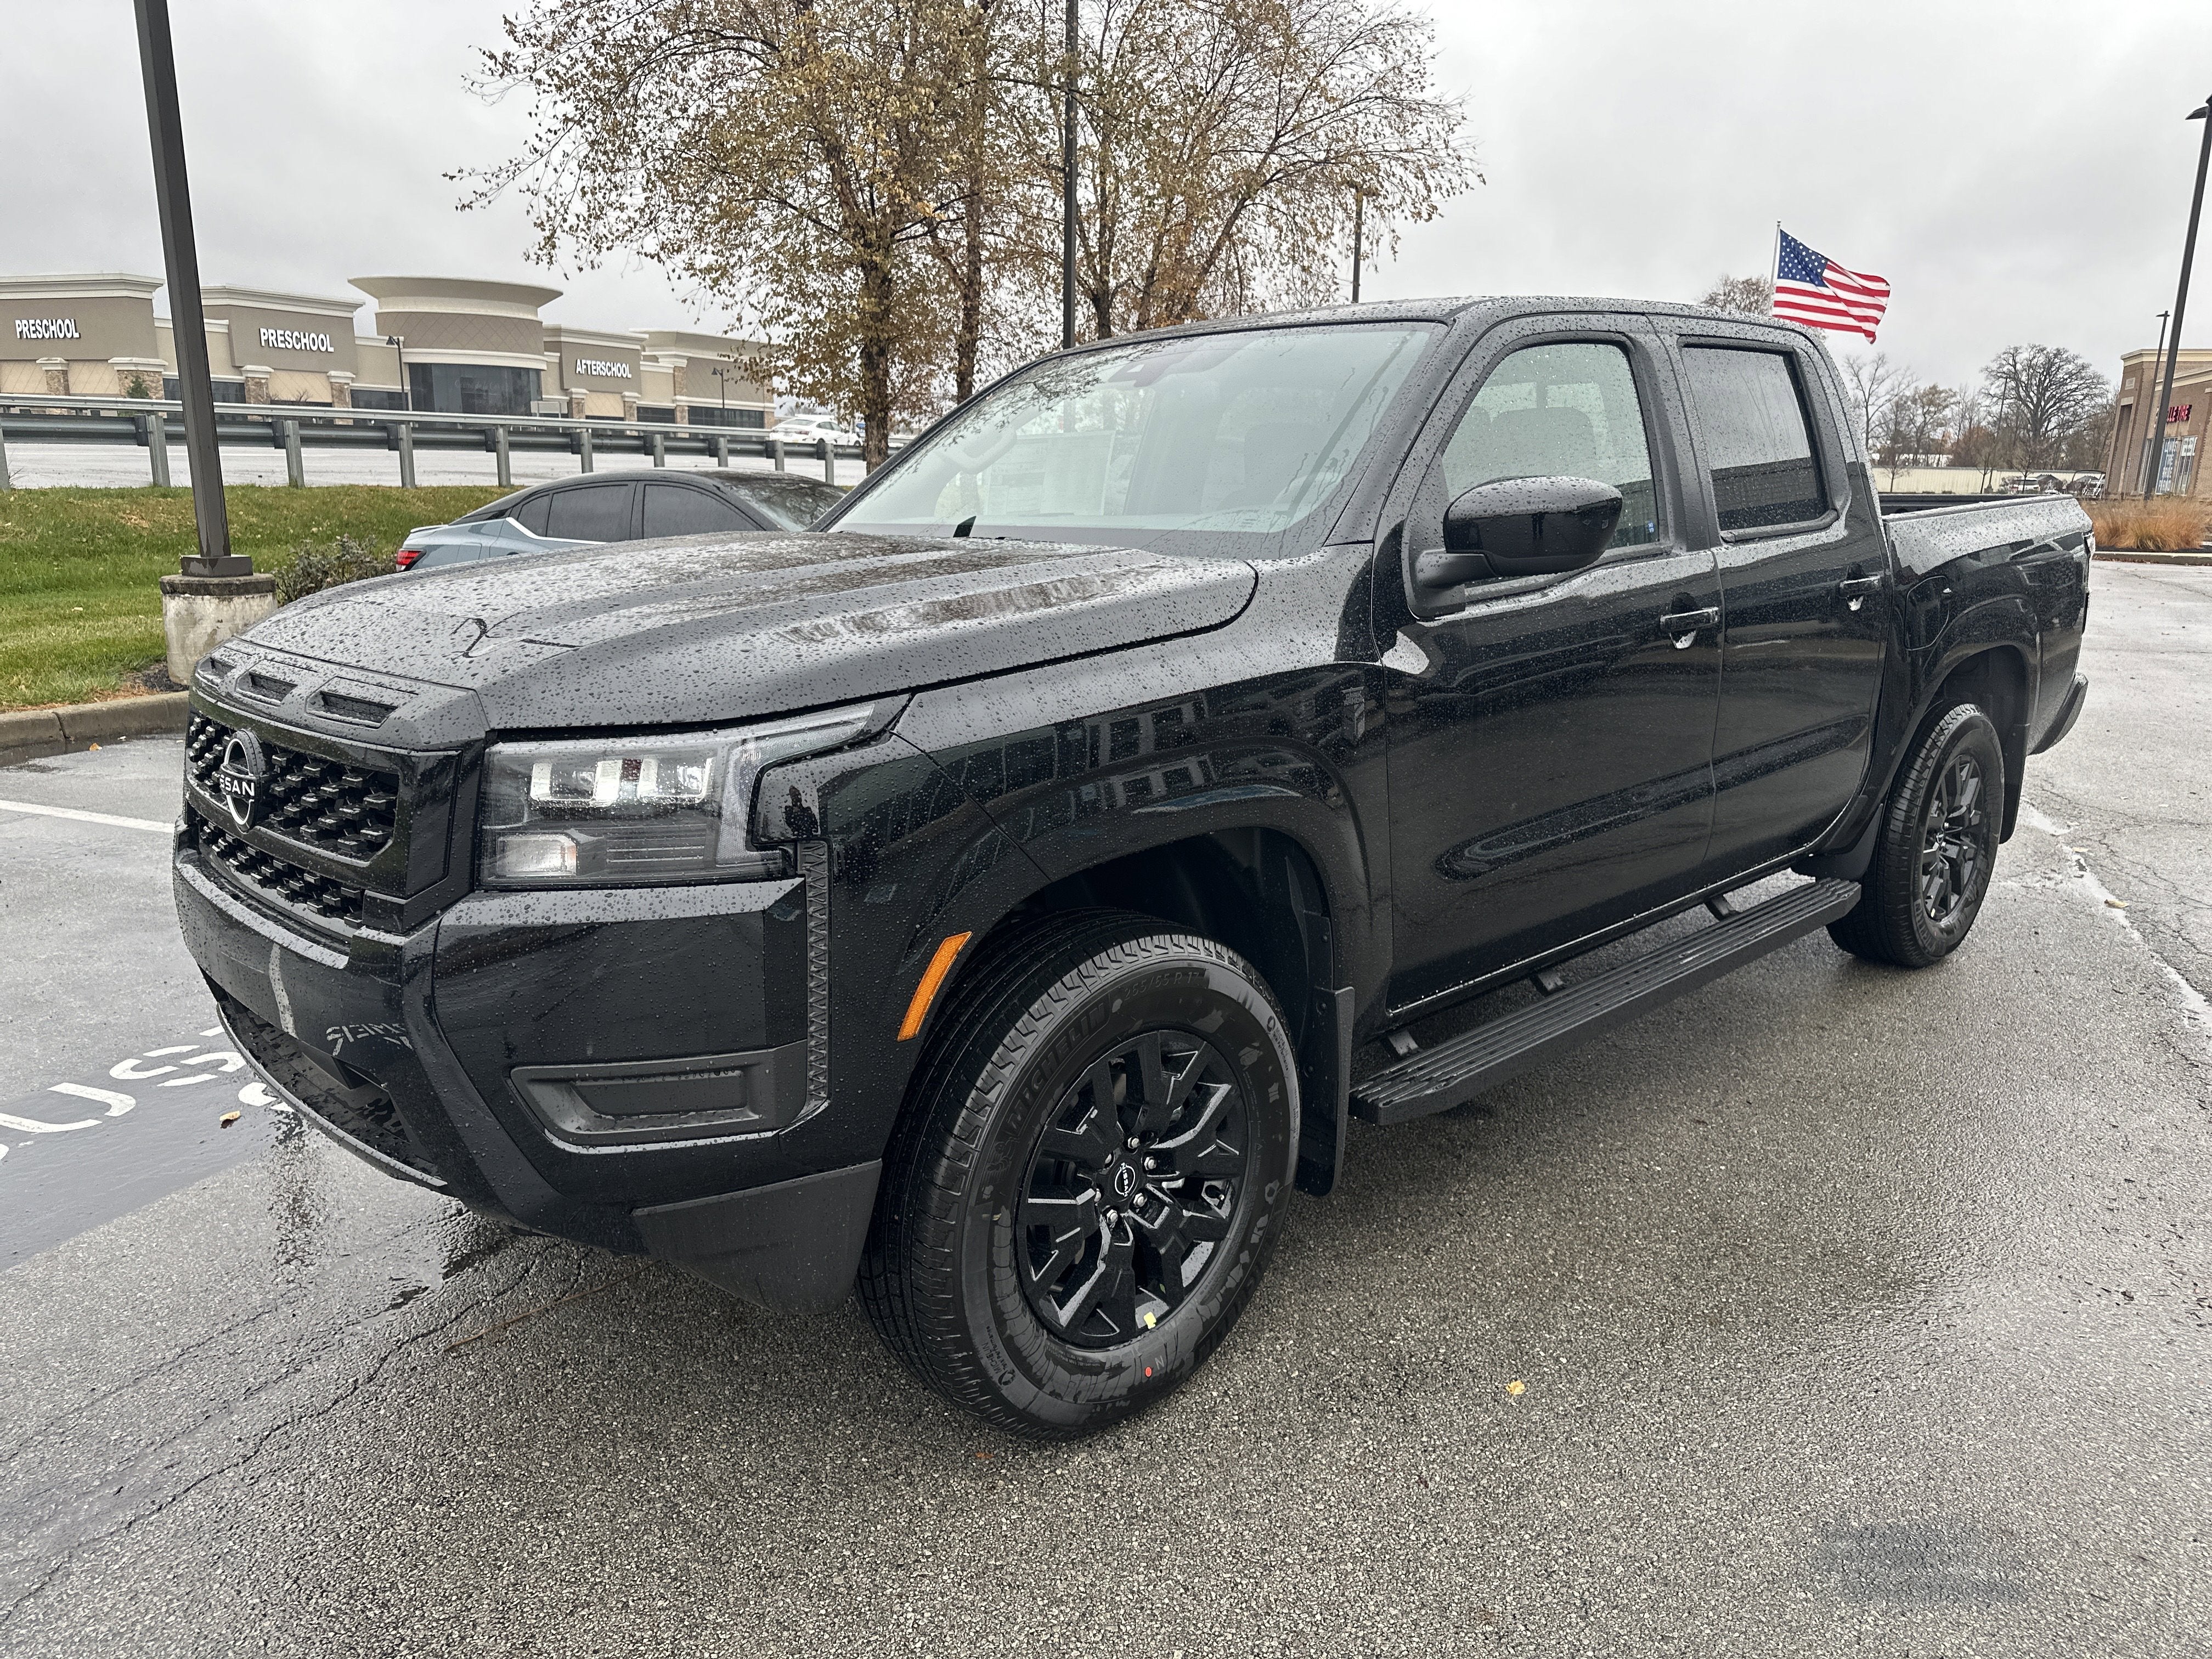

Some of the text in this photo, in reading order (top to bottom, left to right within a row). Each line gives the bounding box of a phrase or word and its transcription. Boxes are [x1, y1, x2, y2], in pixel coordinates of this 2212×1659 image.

[15, 319, 81, 339] PRESCHOOL
[259, 328, 334, 352] PRESCHOOL
[575, 359, 632, 379] AFTERSCHOOL
